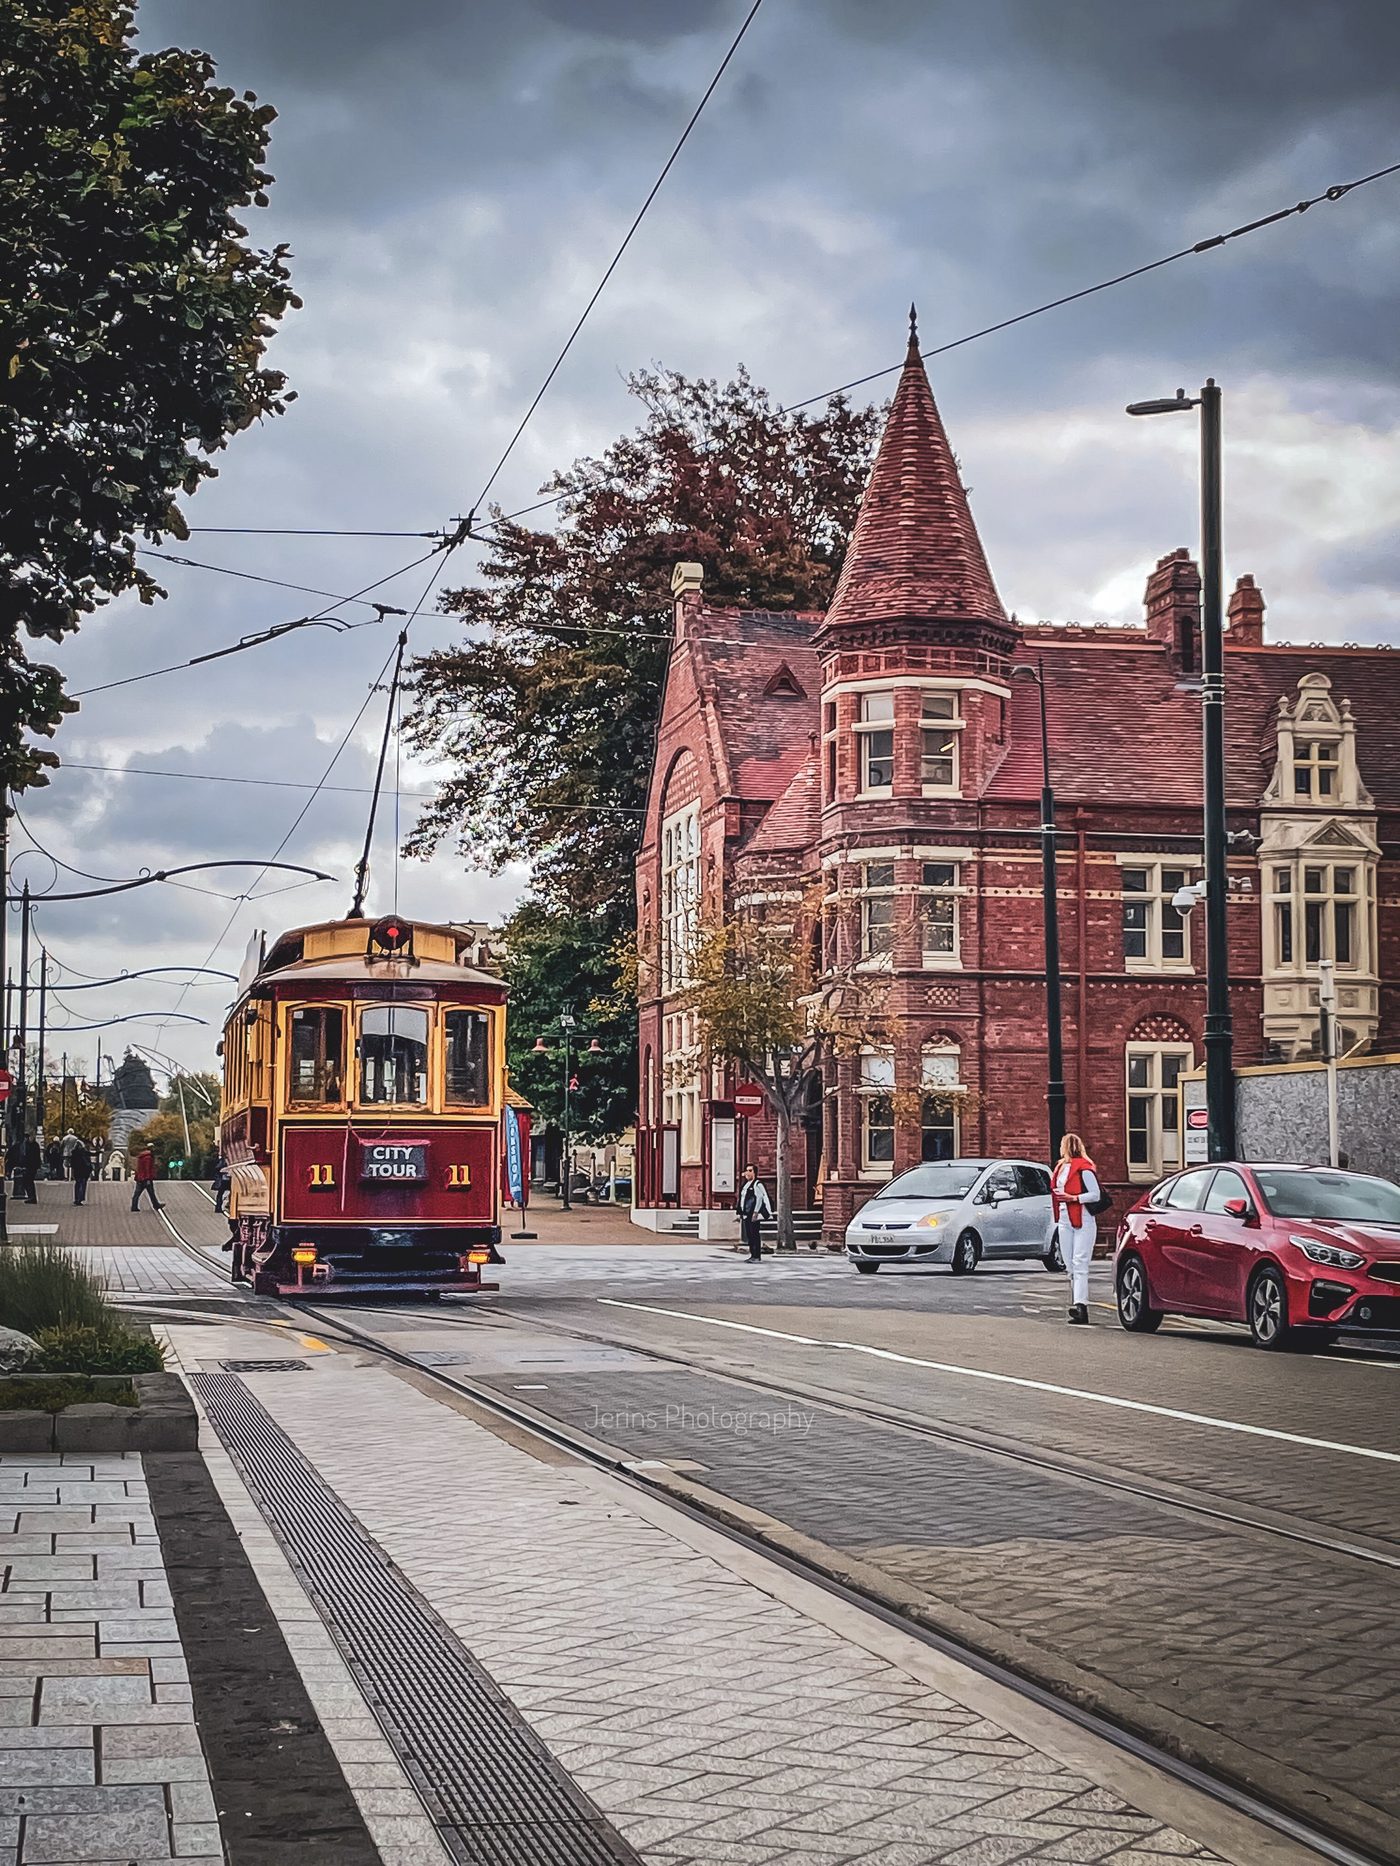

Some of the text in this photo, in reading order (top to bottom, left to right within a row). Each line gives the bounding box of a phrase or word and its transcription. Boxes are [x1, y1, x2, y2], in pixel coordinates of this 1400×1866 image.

[372, 1146, 414, 1160] CITY
[309, 1164, 335, 1186] 11
[368, 1163, 417, 1177] TOUR
[448, 1164, 471, 1186] 11
